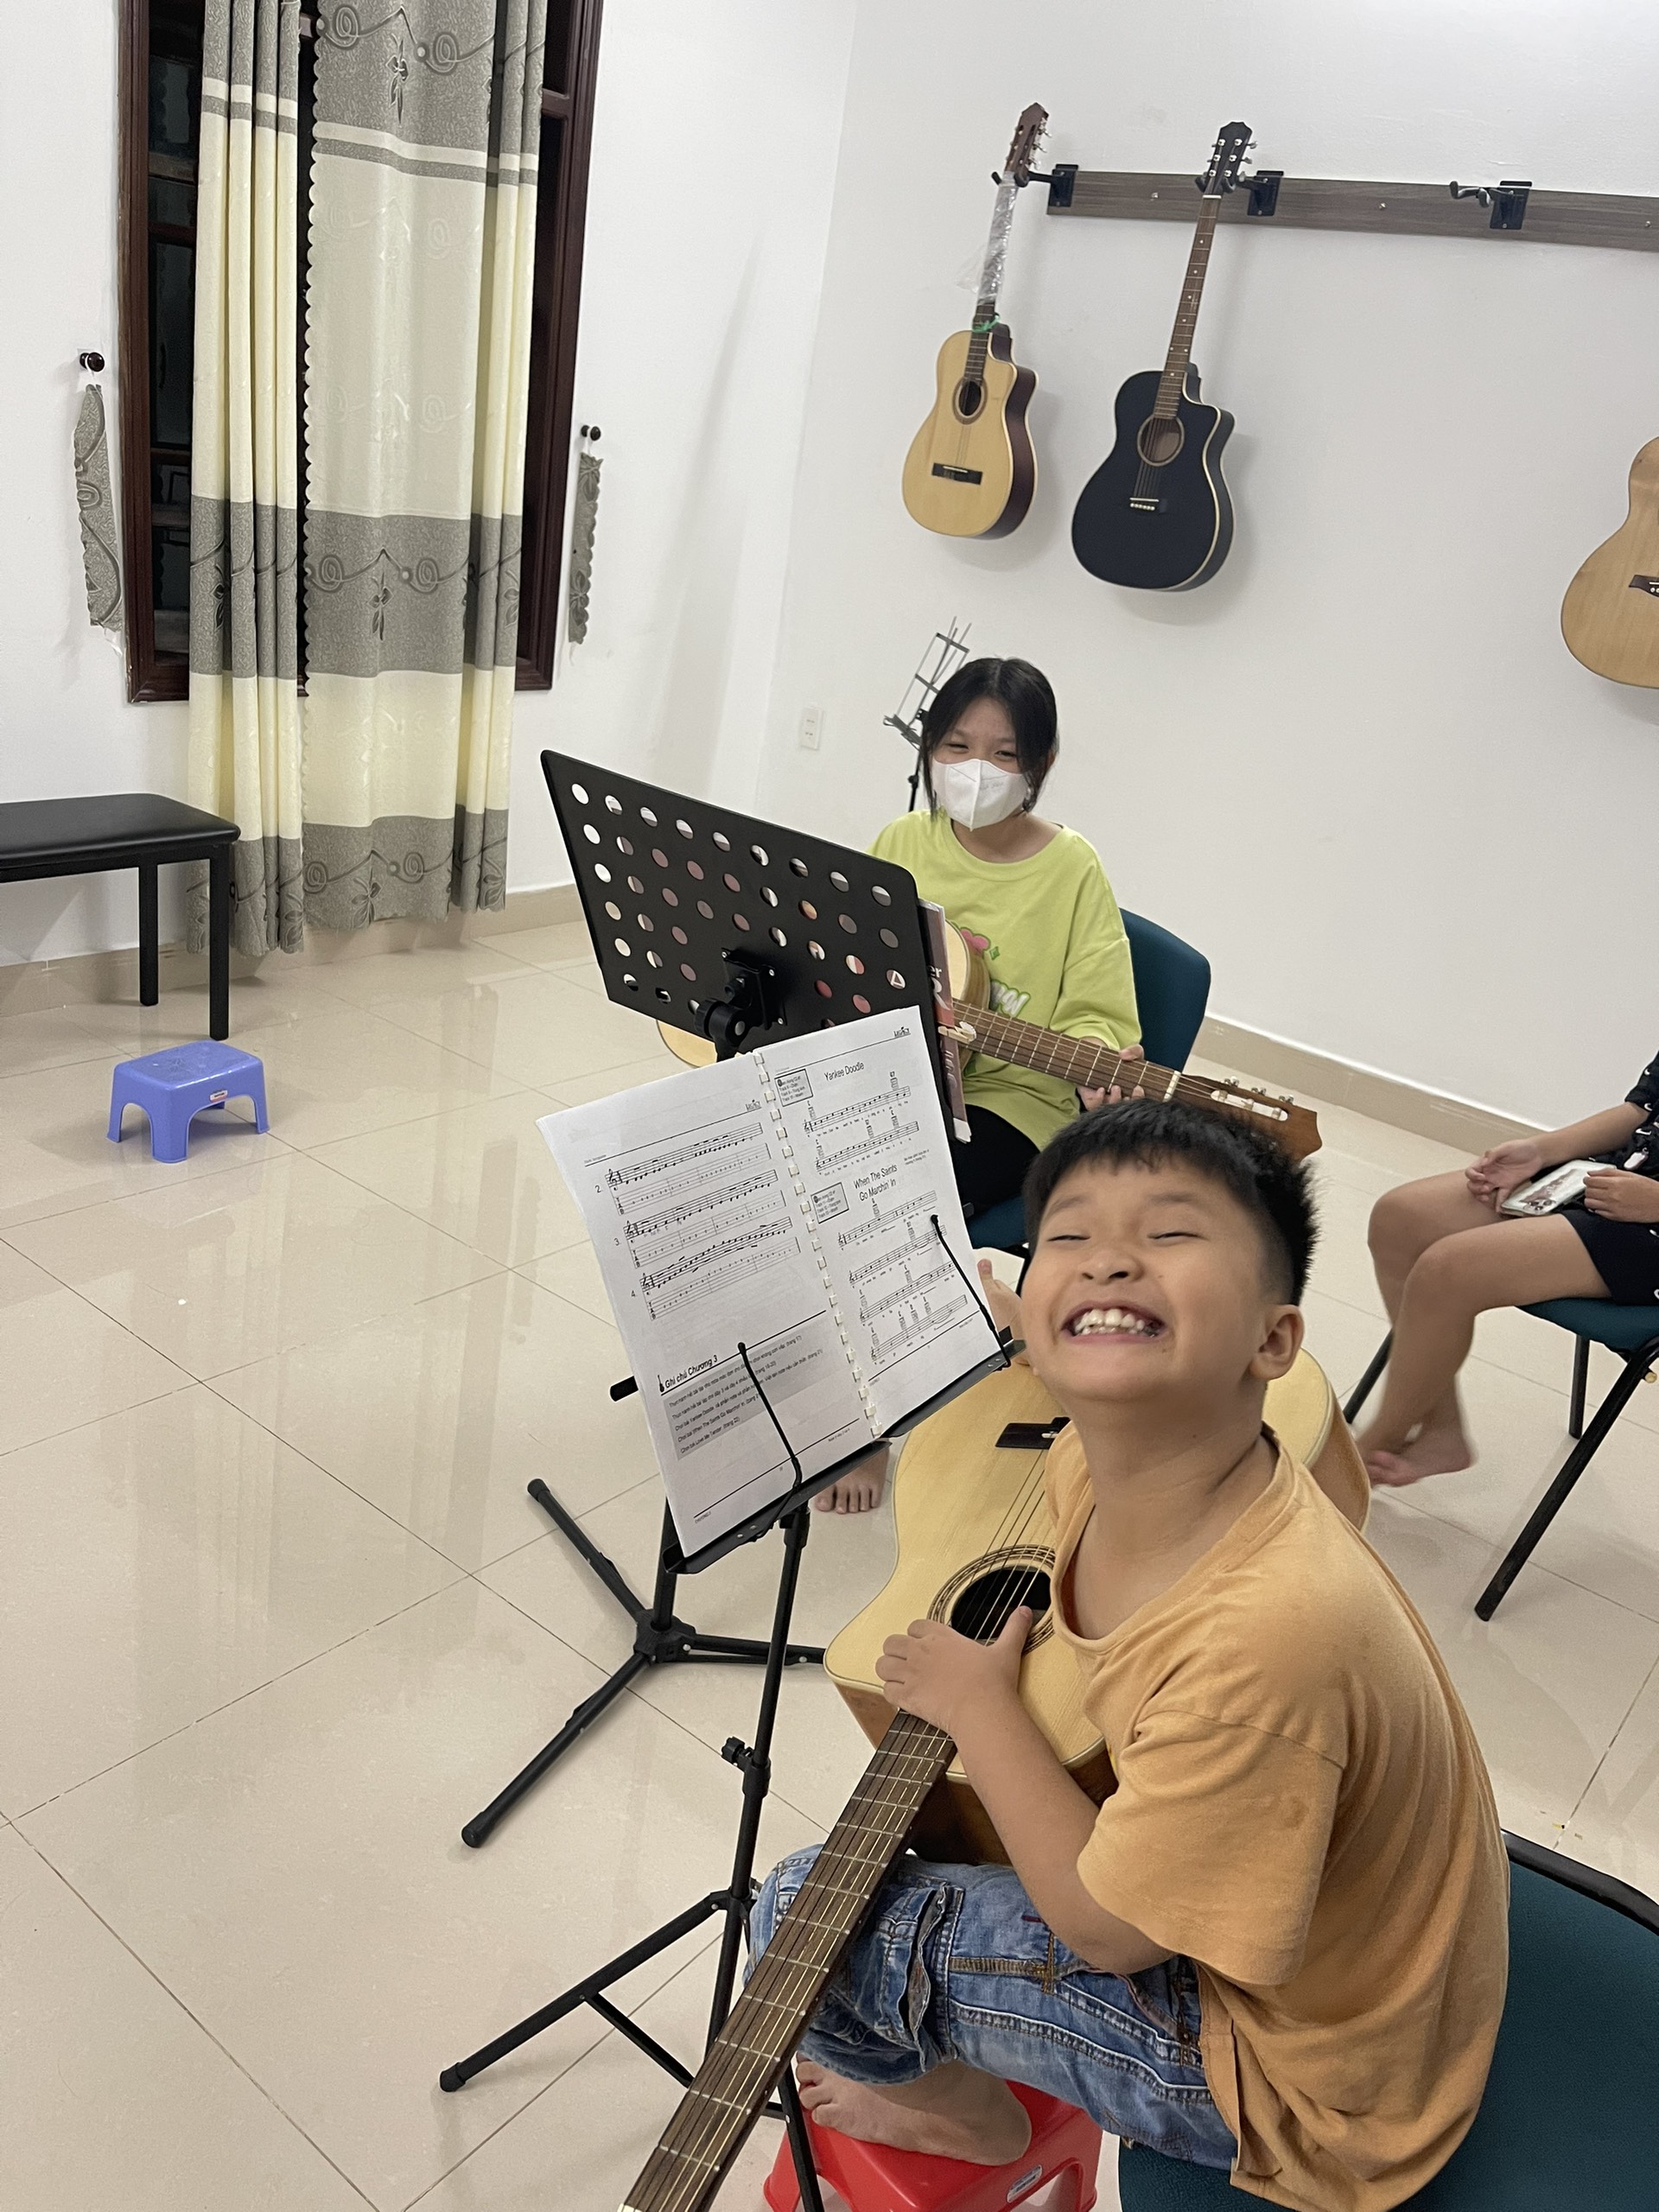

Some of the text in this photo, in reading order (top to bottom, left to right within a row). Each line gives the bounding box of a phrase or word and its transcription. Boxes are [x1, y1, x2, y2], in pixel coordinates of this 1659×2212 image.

[823, 1062, 865, 1081] Yankee Doodle
[854, 1177, 870, 1189] When
[870, 1172, 880, 1181] The
[859, 1192, 868, 1201] Go
[664, 1376, 676, 1389] Ghi
[677, 1370, 688, 1382] chú
[713, 1354, 718, 1363] 3
